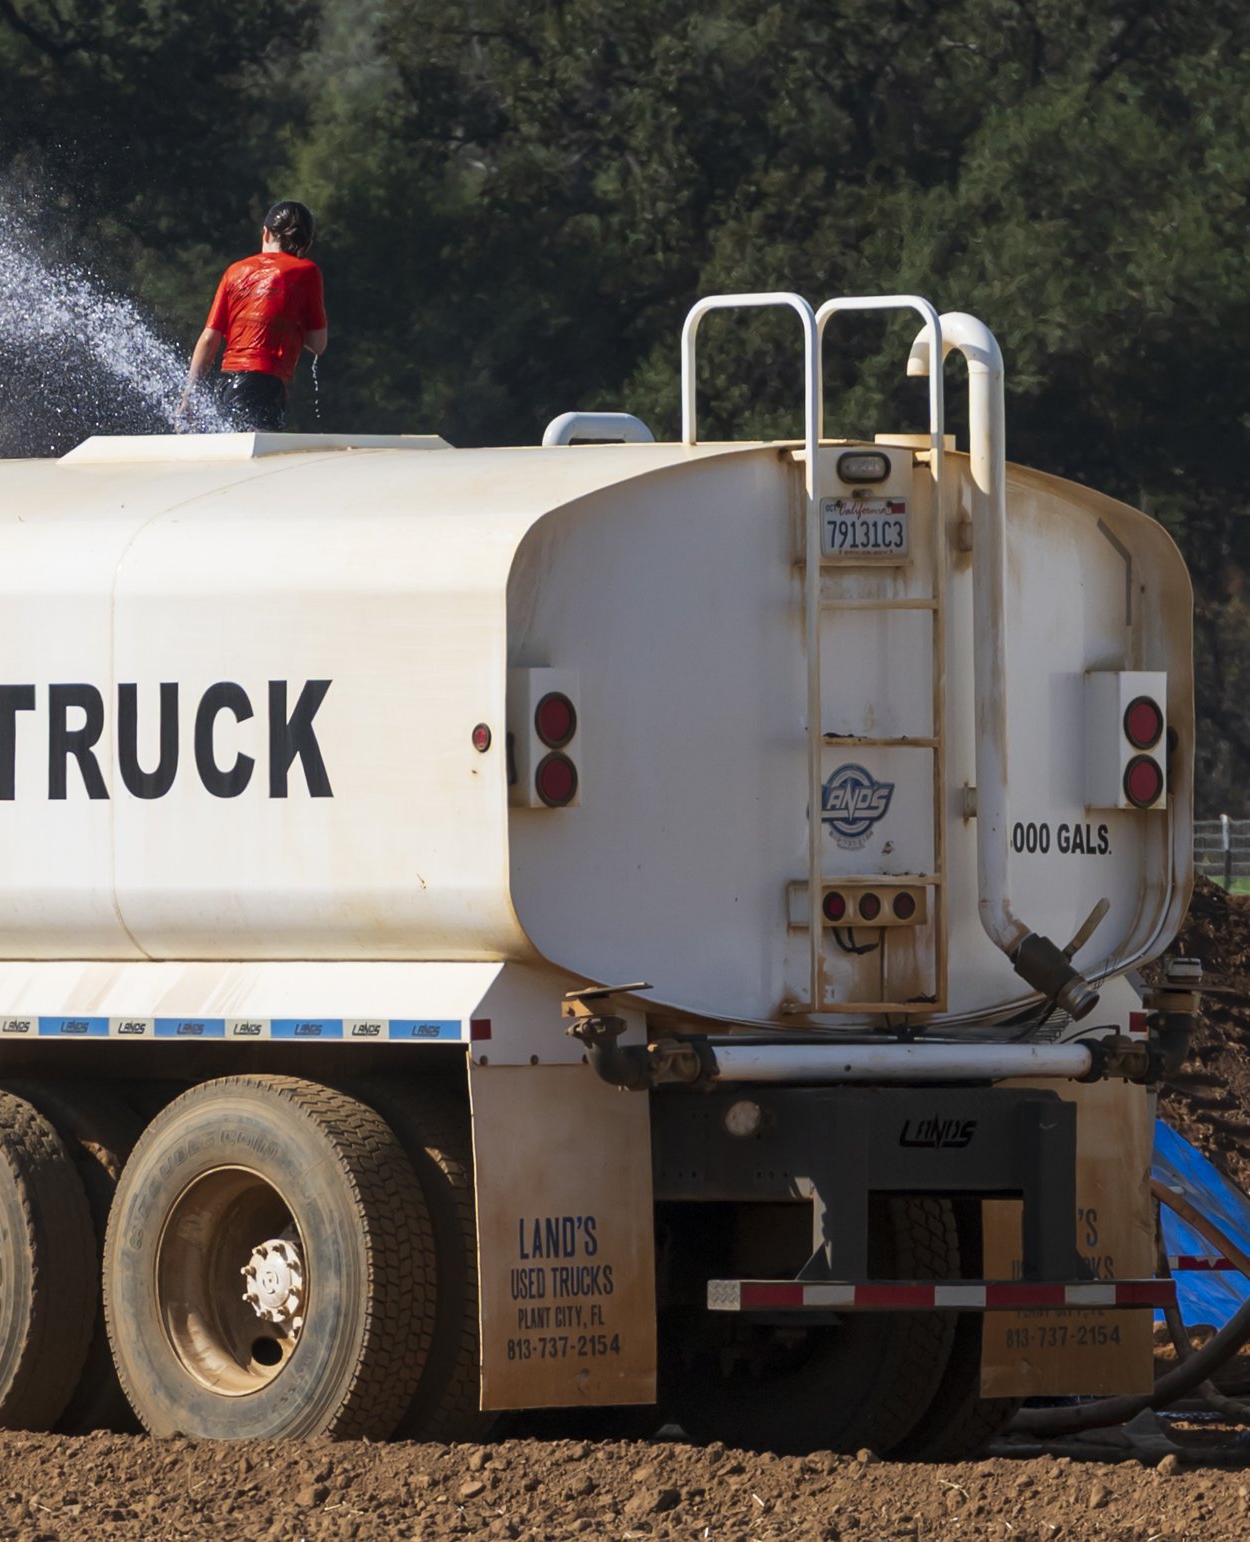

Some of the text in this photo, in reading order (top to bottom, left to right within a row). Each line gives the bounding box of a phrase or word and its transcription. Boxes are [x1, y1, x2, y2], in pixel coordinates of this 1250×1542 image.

[827, 520, 904, 548] 79131C3
[1010, 822, 1112, 855] 000 GALS.
[519, 1216, 598, 1260] LAND'S
[510, 1264, 614, 1300] USED TRUCKS
[518, 1304, 605, 1330] PLANT CITY, FL
[507, 1332, 621, 1361] 813-737-2154
[1005, 1324, 1121, 1349] 813-737-2154
